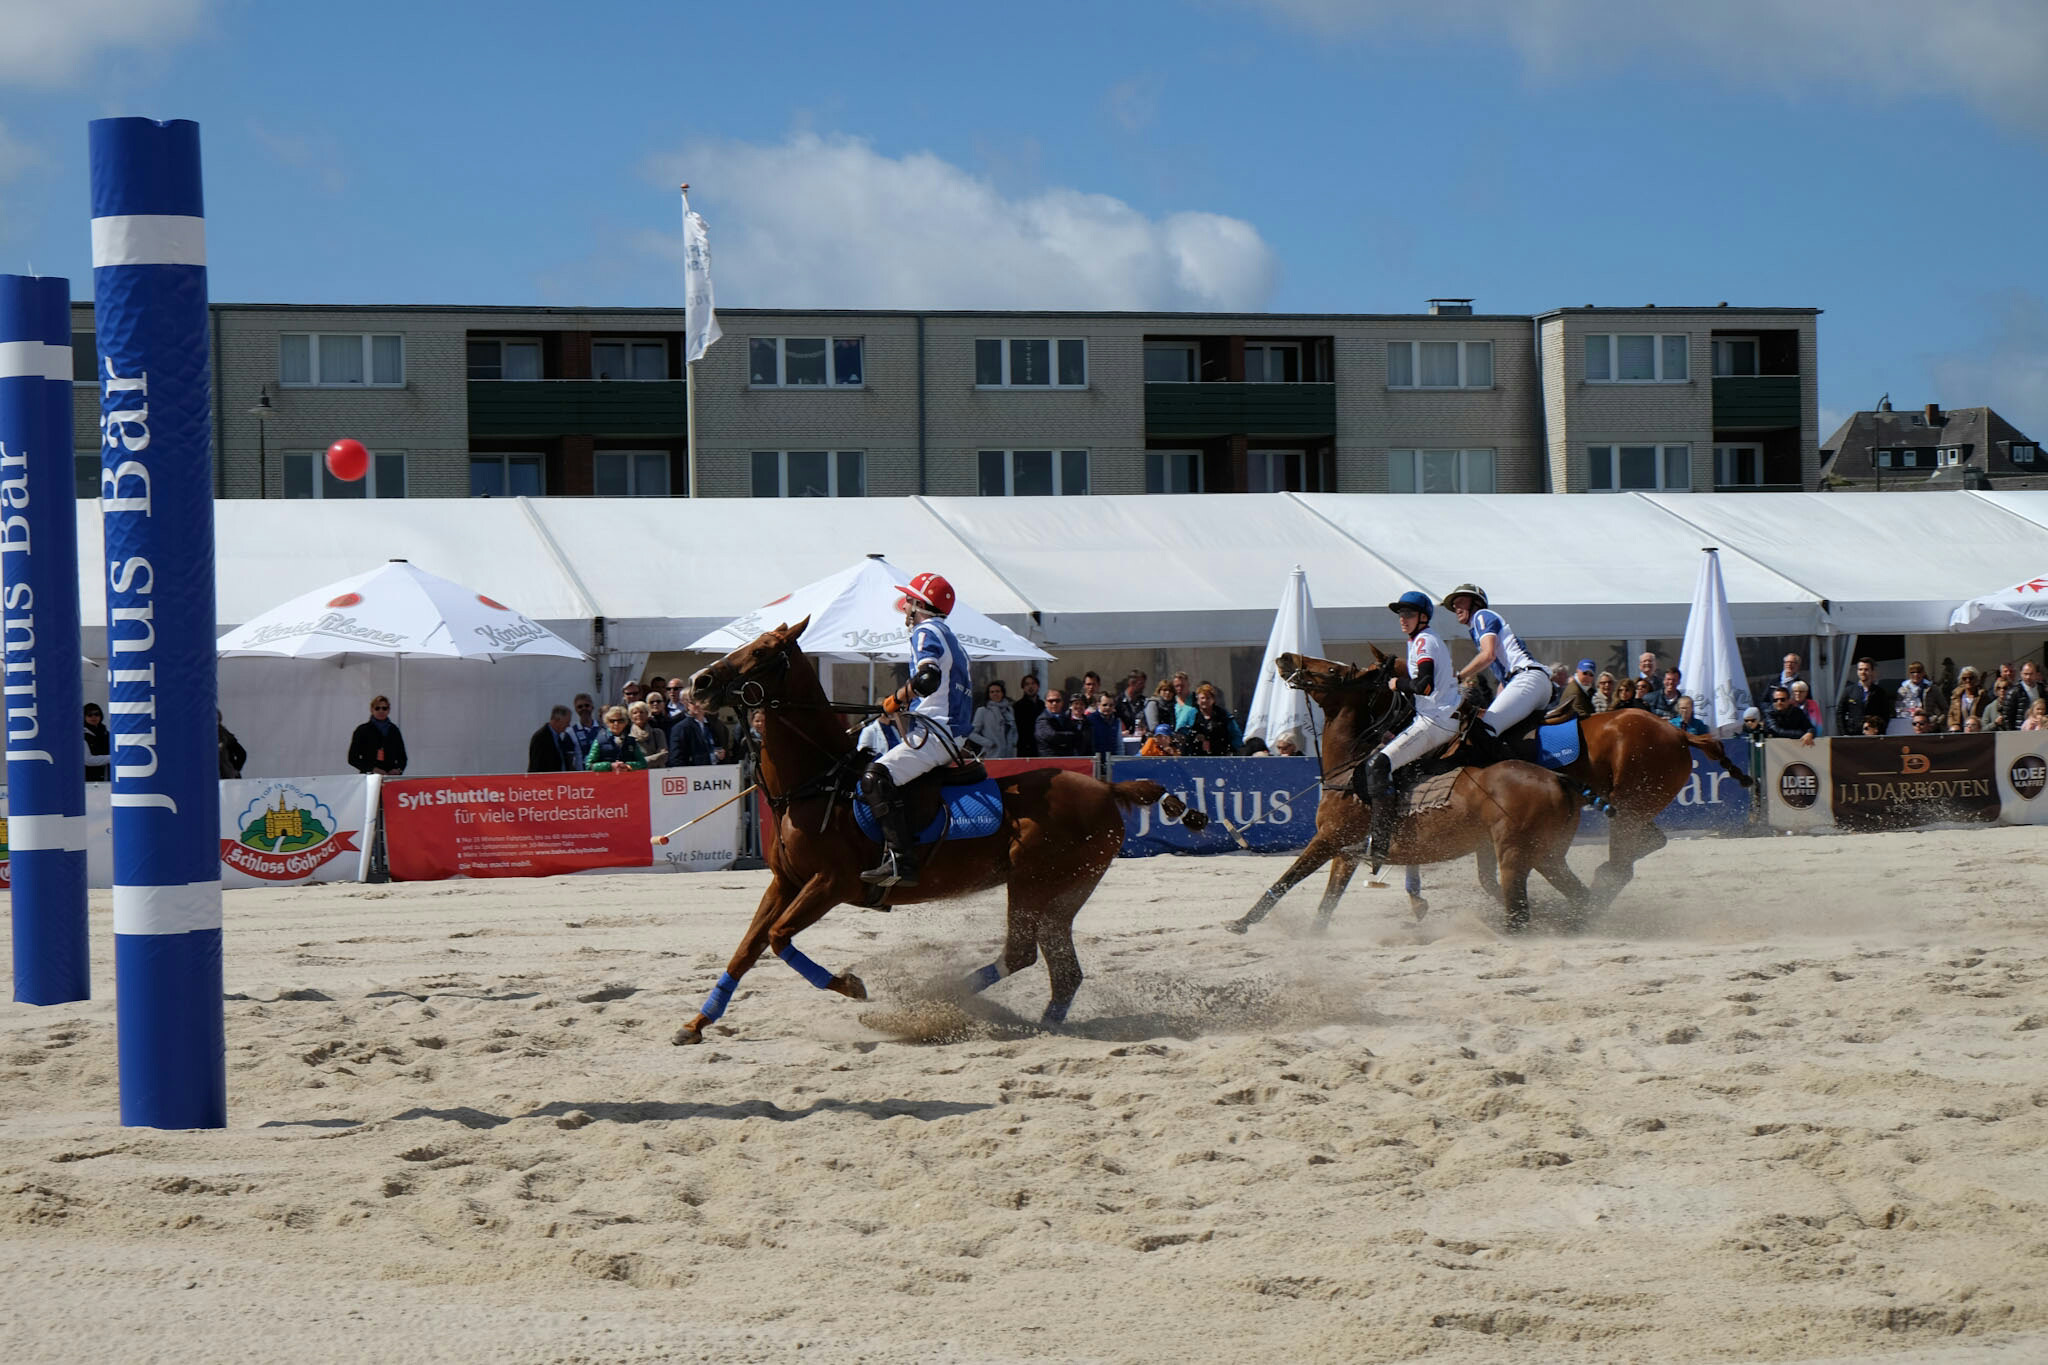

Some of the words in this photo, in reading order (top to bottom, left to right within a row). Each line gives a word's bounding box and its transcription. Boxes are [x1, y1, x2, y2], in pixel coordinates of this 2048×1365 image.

[100, 356, 151, 517] Bär
[316, 612, 408, 644] Pilsener
[1477, 614, 1486, 630] 1
[1415, 637, 1426, 655] 2
[3, 582, 54, 765] Julius
[108, 557, 177, 814] Julius
[1677, 759, 1732, 806] är
[1782, 775, 1815, 788] IDEE
[2012, 766, 2046, 780] IDEE
[664, 779, 686, 793] DB
[693, 779, 732, 791] BAHN
[1783, 787, 1816, 797] KAFFEE
[2014, 779, 2045, 788] KAFFEE
[398, 790, 433, 810] Sylt
[436, 787, 505, 806] Shuttle:
[508, 786, 555, 802] bietet
[557, 784, 595, 800] Platz
[454, 809, 475, 824] für
[478, 807, 515, 823] viele
[518, 803, 629, 822] Pferdestärken!
[226, 844, 285, 874] Schloss
[665, 851, 687, 863] Sylt
[690, 849, 733, 861] Shuttle
